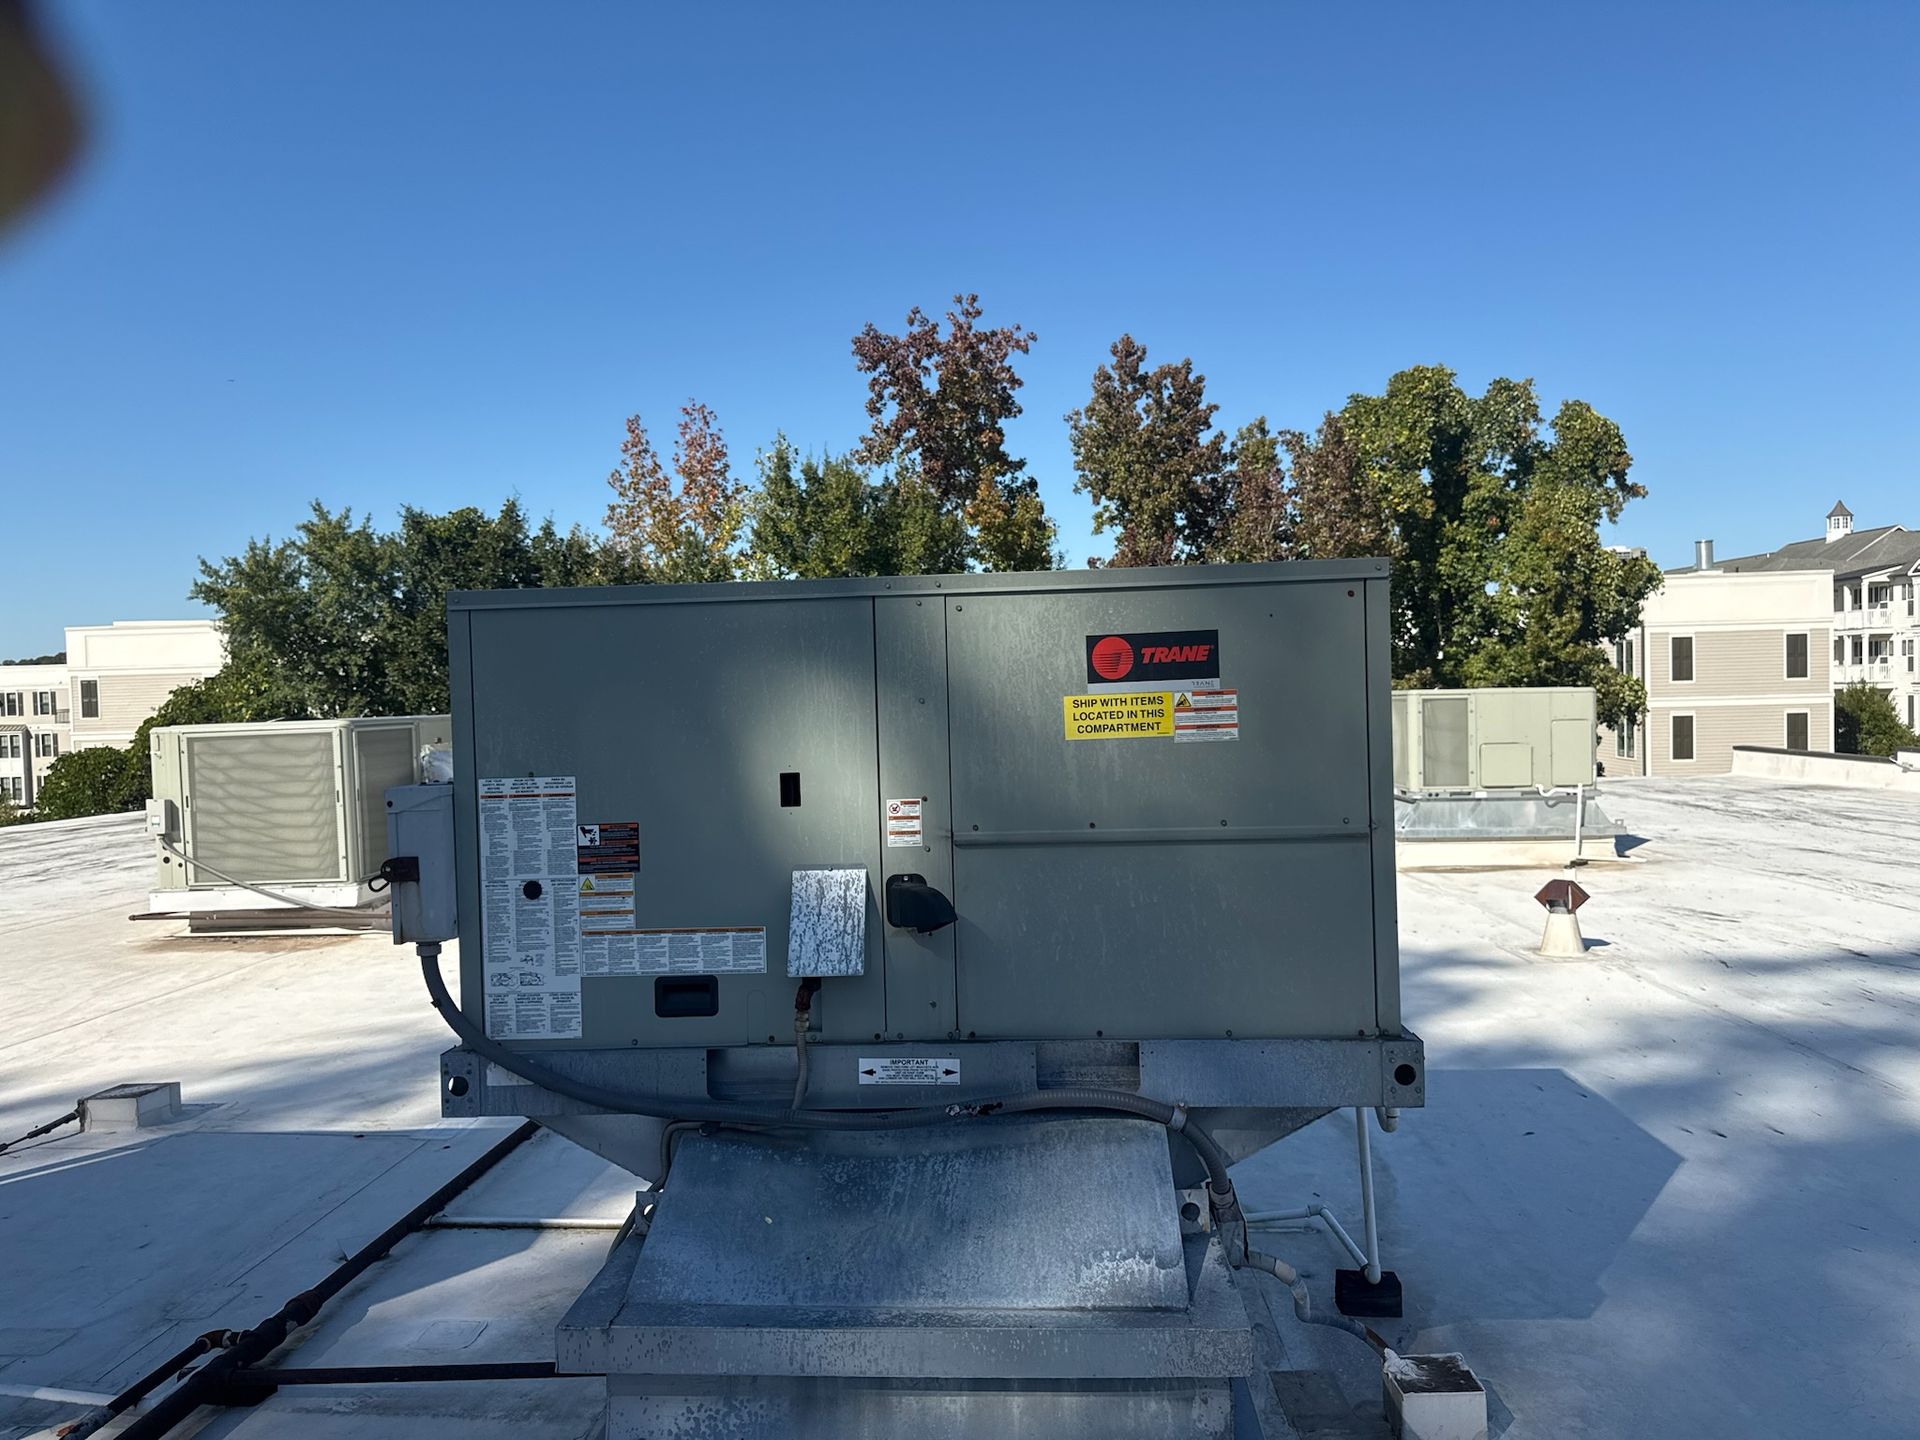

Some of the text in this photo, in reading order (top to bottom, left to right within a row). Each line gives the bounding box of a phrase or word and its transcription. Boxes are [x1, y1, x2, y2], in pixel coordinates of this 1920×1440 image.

[1141, 645, 1210, 664] TRANE
[1072, 696, 1164, 708] SHIP WITH ITEMS
[1073, 711, 1124, 721] LOCATED
[1127, 710, 1137, 719] IN
[1140, 708, 1165, 718] THIS
[1077, 721, 1162, 734] COMPARTMENT
